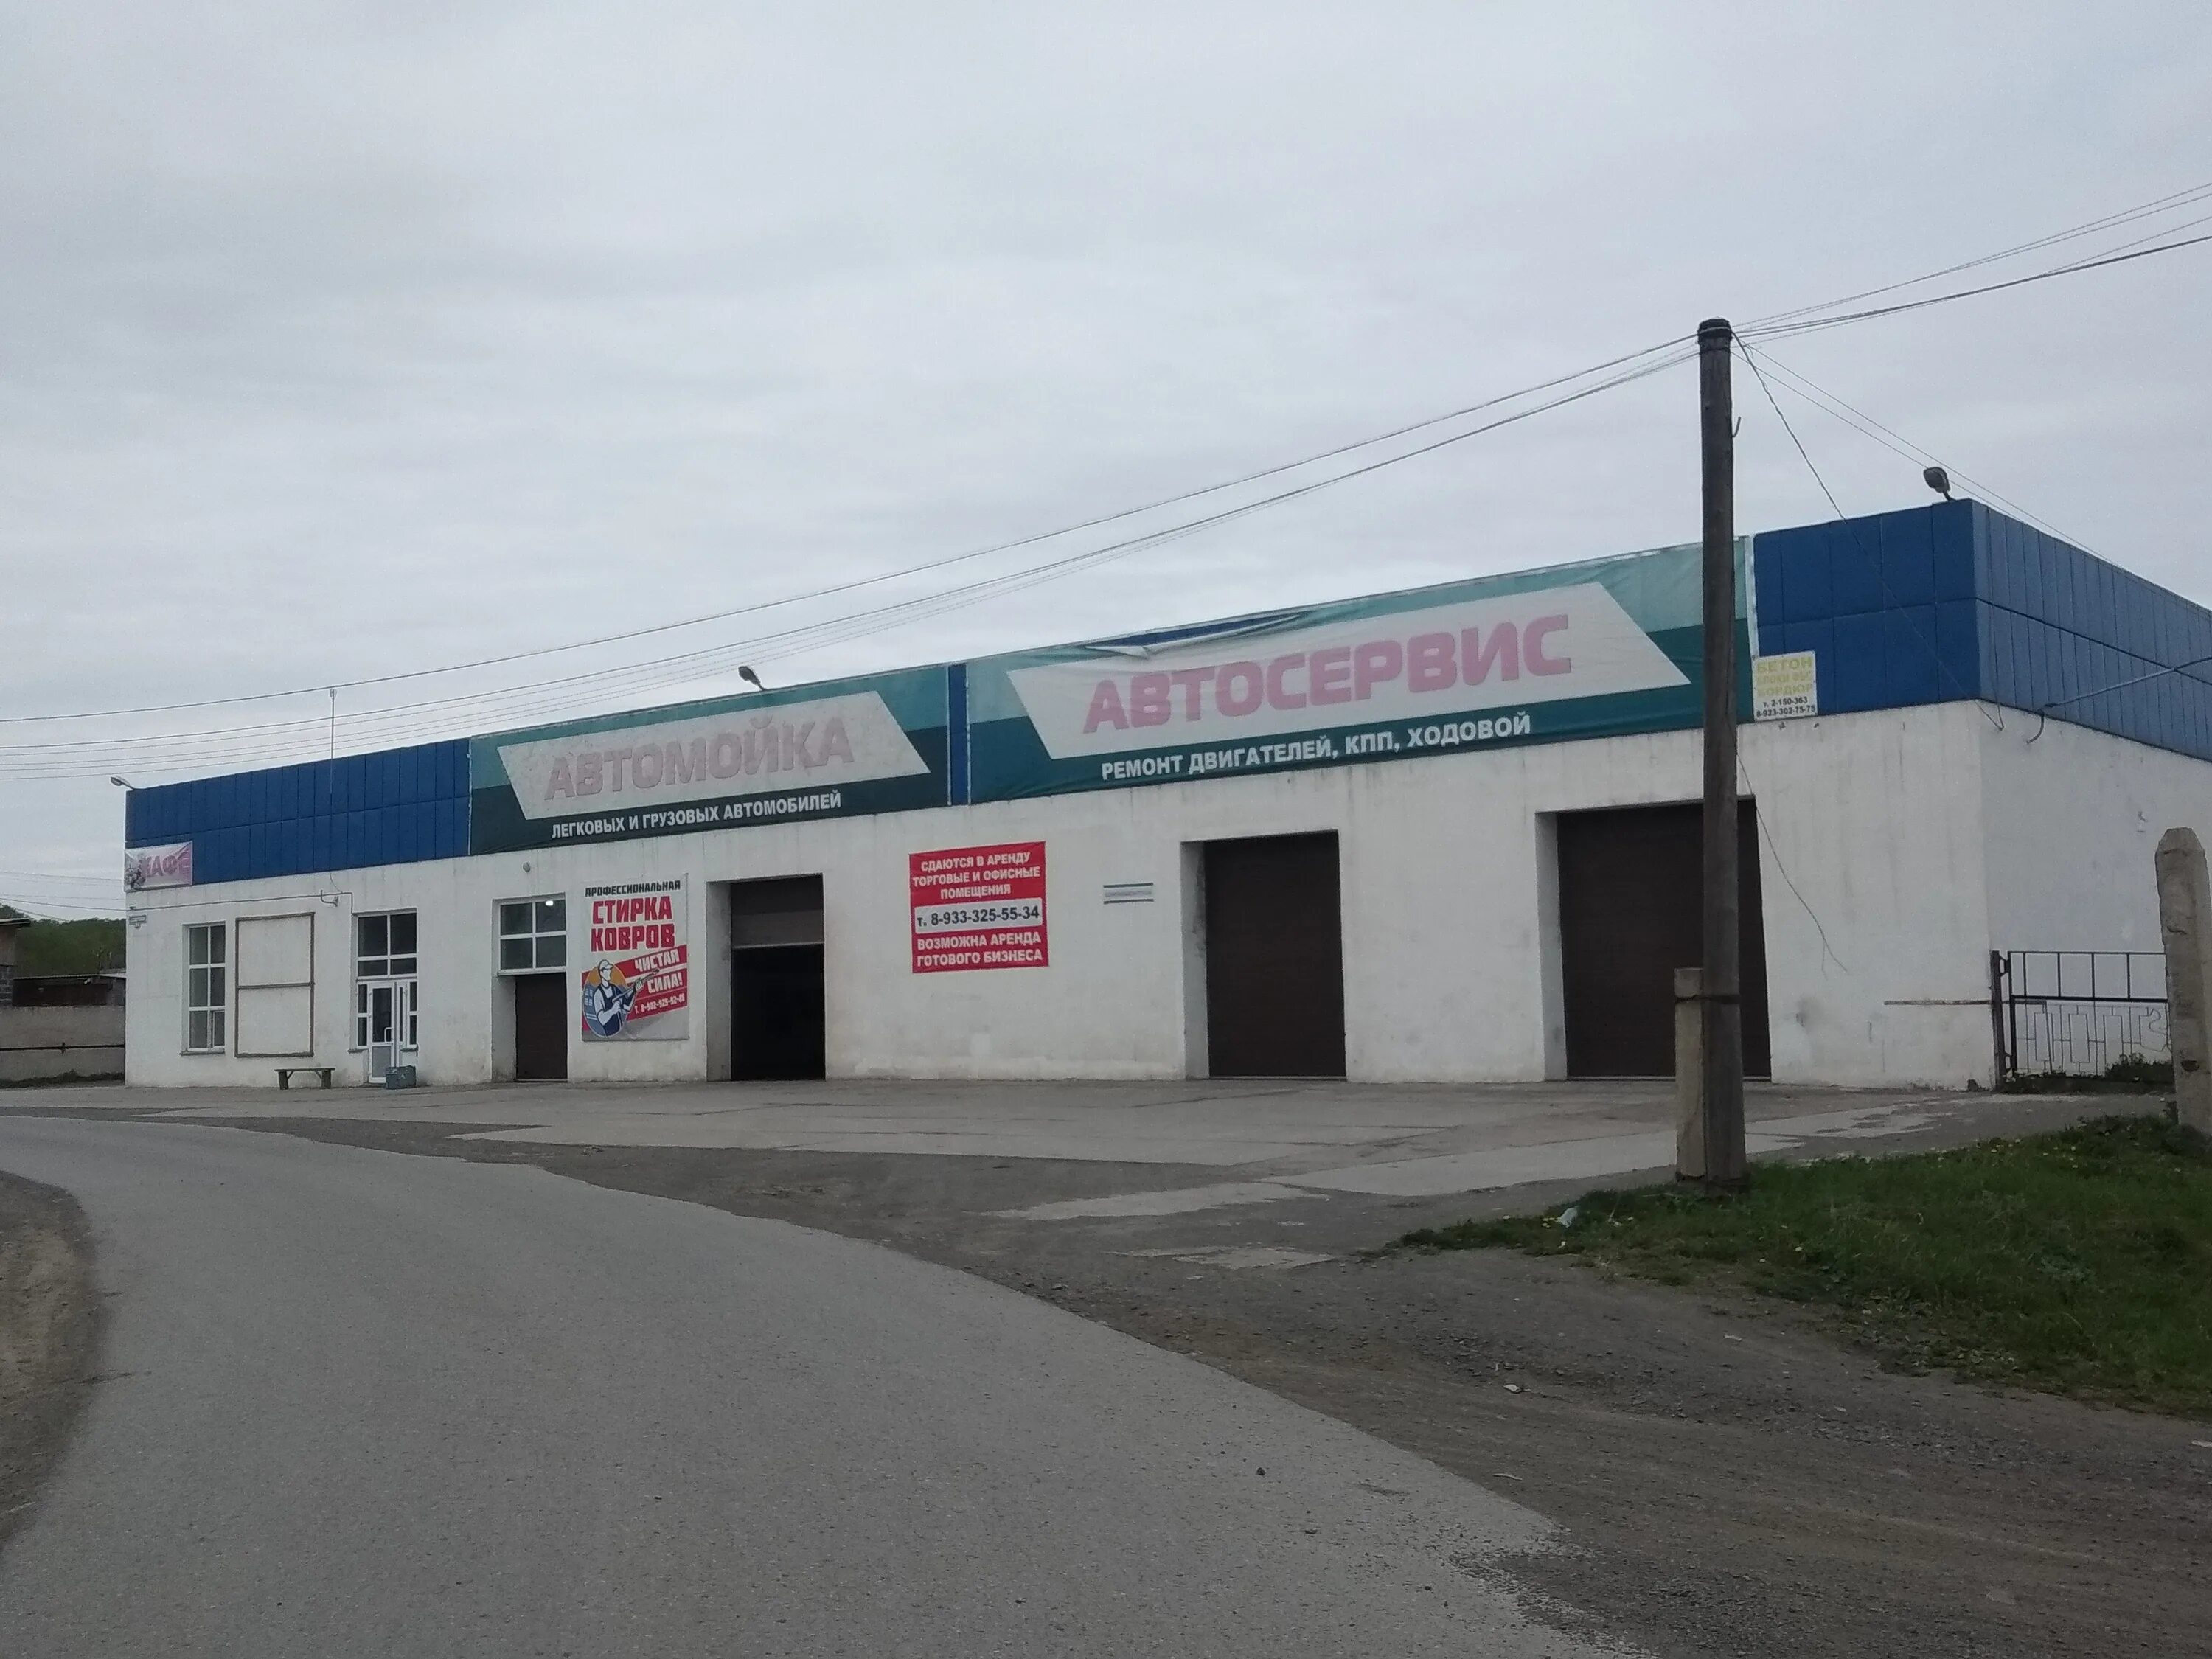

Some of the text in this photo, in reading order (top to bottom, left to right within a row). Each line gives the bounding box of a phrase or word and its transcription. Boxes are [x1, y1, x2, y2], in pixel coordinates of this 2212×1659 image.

[1082, 614, 1571, 734] АВТОСЕРВИС
[1758, 657, 1812, 672] БЕТОН
[1102, 712, 1531, 781] РЕМОНТ ДВИГАТЕЛЕЙ, КПП, ХОДОВОЙ
[544, 714, 855, 801] АВТОМОЙКА
[552, 789, 841, 839] ЛЕГКОВЫХ И ГРУЗОВЫХ АВТОМОБИЛЕЙ
[921, 852, 1031, 873] СДАЮТСЯ В АРЕНДУ
[912, 866, 1040, 887] ТОРГОВЫЕ И ОФИСНЫЕ
[585, 880, 681, 897] ПРОФЕССИОНАЛЬНАЯ
[940, 884, 1011, 900] ПОМЕЩЕНИЯ
[592, 896, 672, 924] СТИРКА
[917, 905, 1040, 927] т. 8-933-325-55-34
[591, 923, 675, 952] КОВРОВ
[917, 931, 1041, 950] ВОЗМОЖНА АРЕНДА
[634, 948, 680, 972] ЧИСТАЯ
[917, 949, 1043, 967] ГОТОВОГО БИЗНЕСА
[647, 972, 683, 993] СИЛА!
